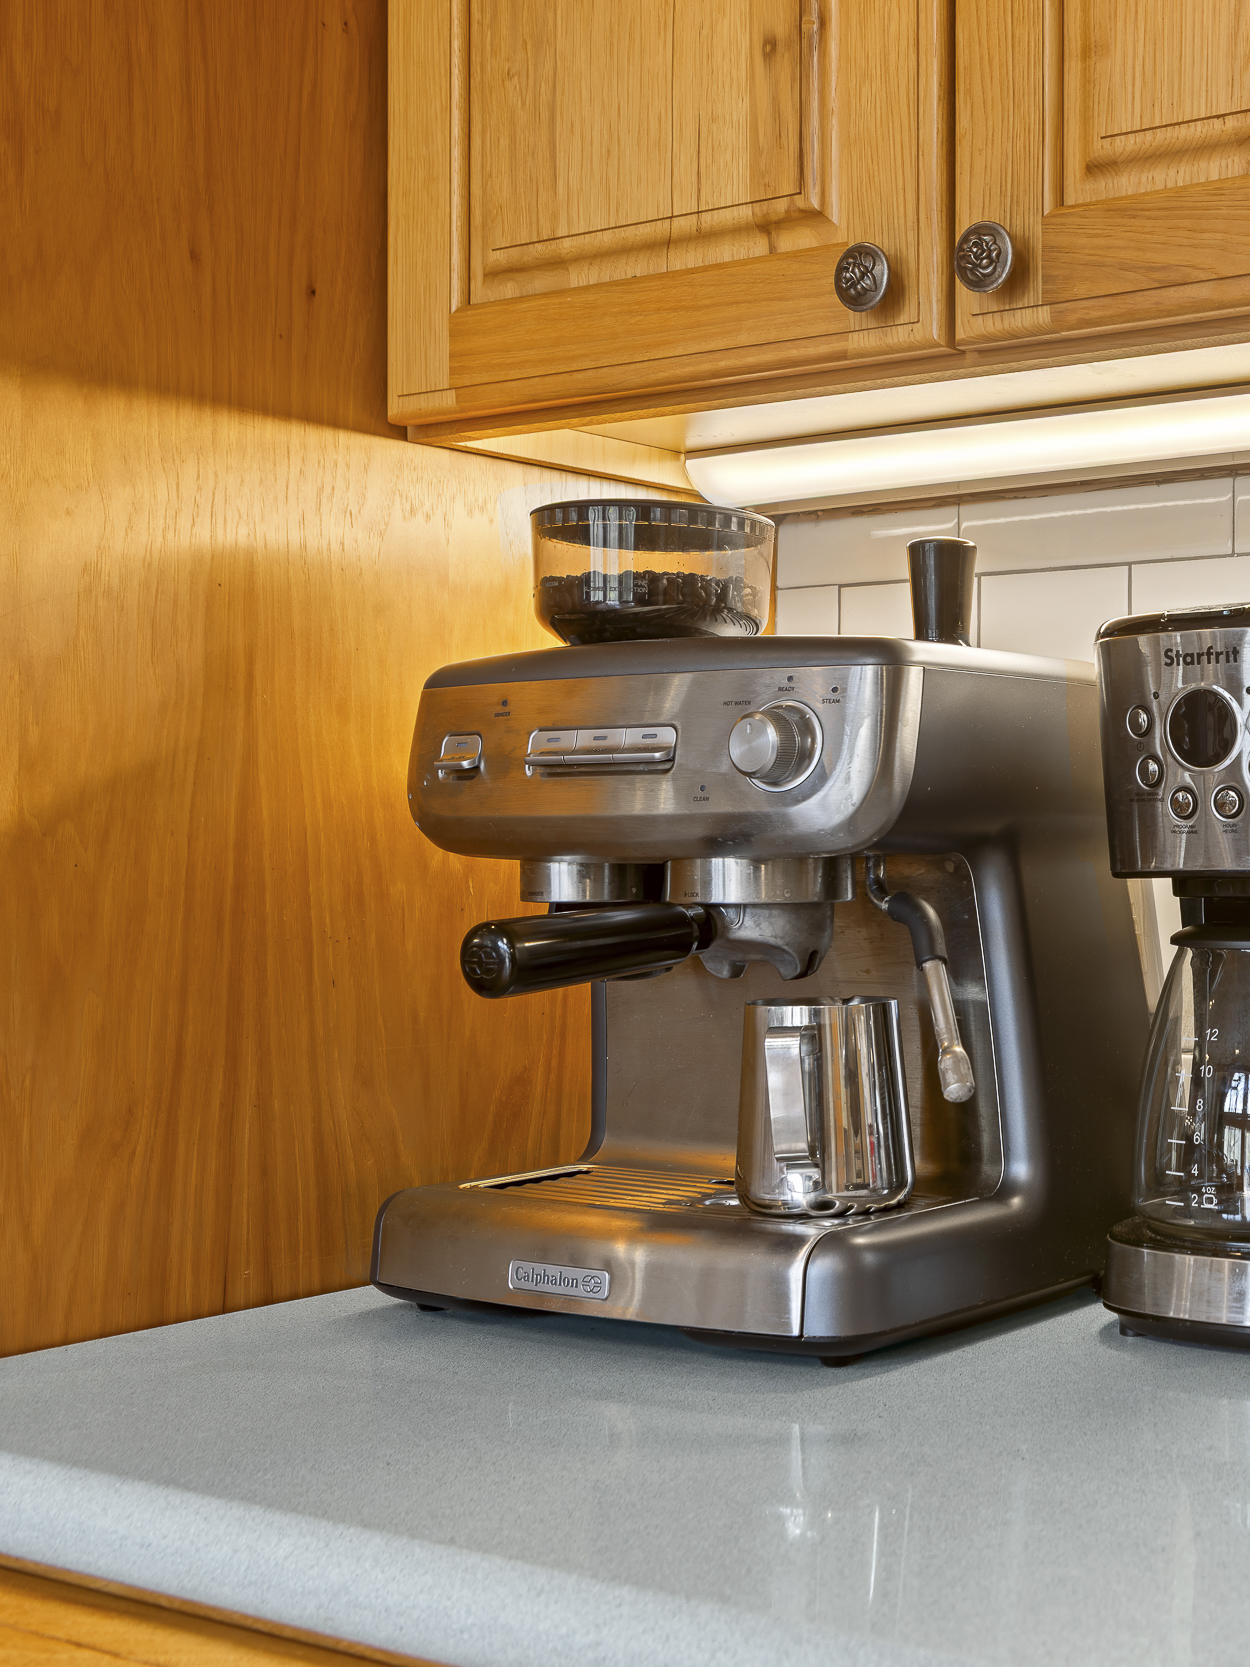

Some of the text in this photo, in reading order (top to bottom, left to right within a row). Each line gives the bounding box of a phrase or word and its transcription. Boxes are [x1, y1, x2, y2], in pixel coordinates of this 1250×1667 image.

[1164, 645, 1240, 667] Starfrit
[1205, 1028, 1219, 1041] 12
[1199, 1064, 1213, 1078] 10
[1196, 1098, 1204, 1111] 8
[1193, 1132, 1201, 1145] 6
[1191, 1163, 1199, 1177] 4
[1191, 1193, 1199, 1207] 2
[514, 1266, 579, 1289] Calphalon
